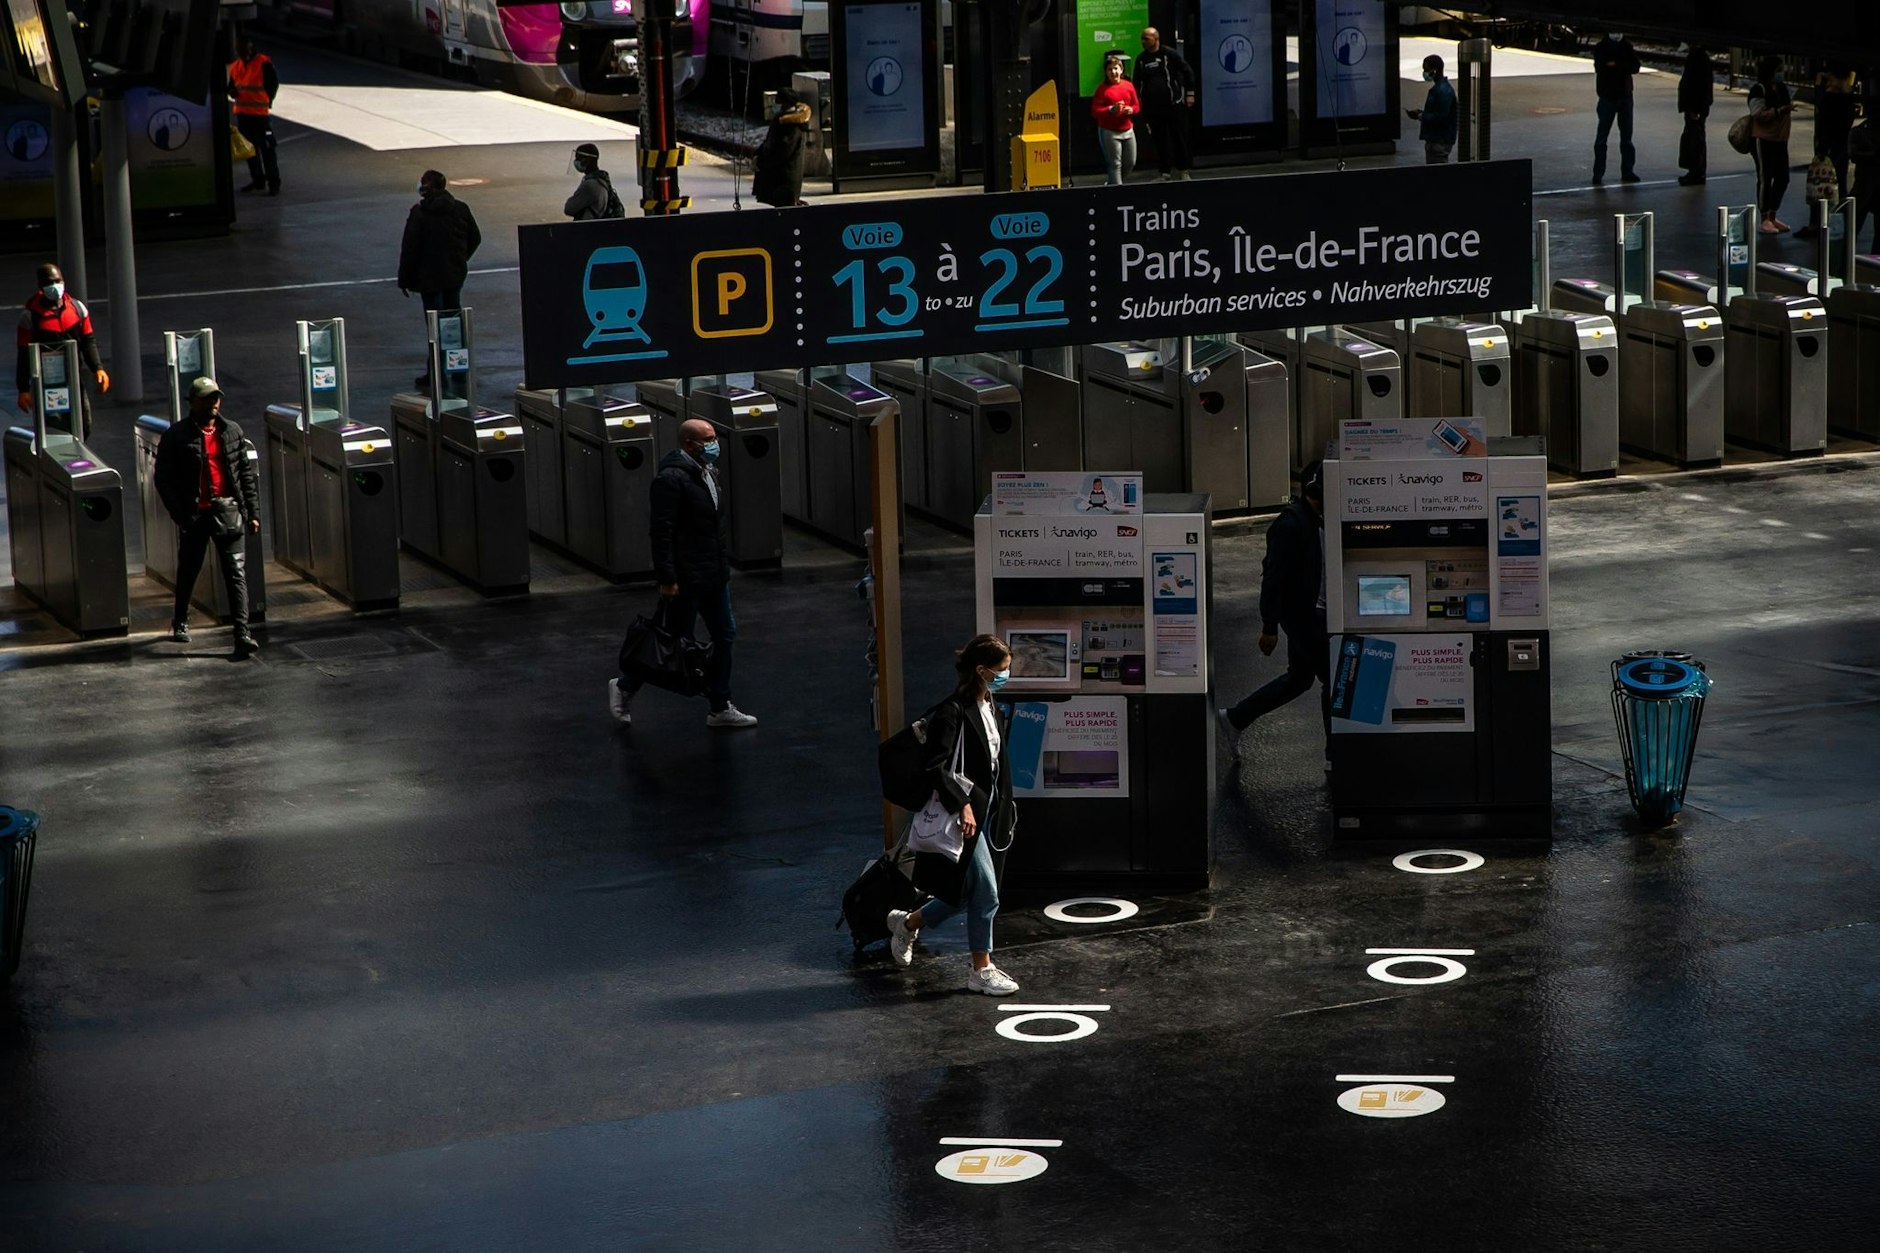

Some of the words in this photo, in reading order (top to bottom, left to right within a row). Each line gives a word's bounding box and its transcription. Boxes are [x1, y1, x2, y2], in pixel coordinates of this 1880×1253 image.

[1028, 112, 1056, 121] Alarme
[1034, 150, 1051, 163] 7106
[1117, 203, 1200, 232] Trains
[850, 226, 895, 246] Voie
[998, 216, 1042, 236] Voie
[1121, 239, 1221, 284] Paris,
[1228, 225, 1480, 274] Île-de-France
[832, 256, 919, 328] 13
[936, 243, 958, 282] à
[979, 245, 1064, 318] 22
[925, 296, 941, 311] to
[955, 294, 973, 309] zu
[1119, 293, 1222, 320] Suburban
[1226, 287, 1307, 312] services
[1330, 275, 1492, 304] Nahverkehrszug
[1348, 477, 1387, 486] TICKETS
[1407, 473, 1443, 486] navigo
[1422, 496, 1442, 504] train,
[1444, 495, 1461, 503] RER,
[1463, 495, 1479, 503] bus,
[1348, 505, 1409, 513] ÎLE-DE-FRANCE
[1422, 505, 1457, 513] tramway,
[999, 529, 1039, 538] TICKETS
[1059, 527, 1097, 539] navigo
[1117, 527, 1137, 536] SNCF
[1118, 550, 1134, 558] bus,
[1000, 559, 1062, 567] ÎLE-DE-FRANCE
[1075, 560, 1112, 568] tramway,
[1114, 559, 1138, 567] métro
[1363, 648, 1393, 660] navigo
[1015, 709, 1045, 723] navigo
